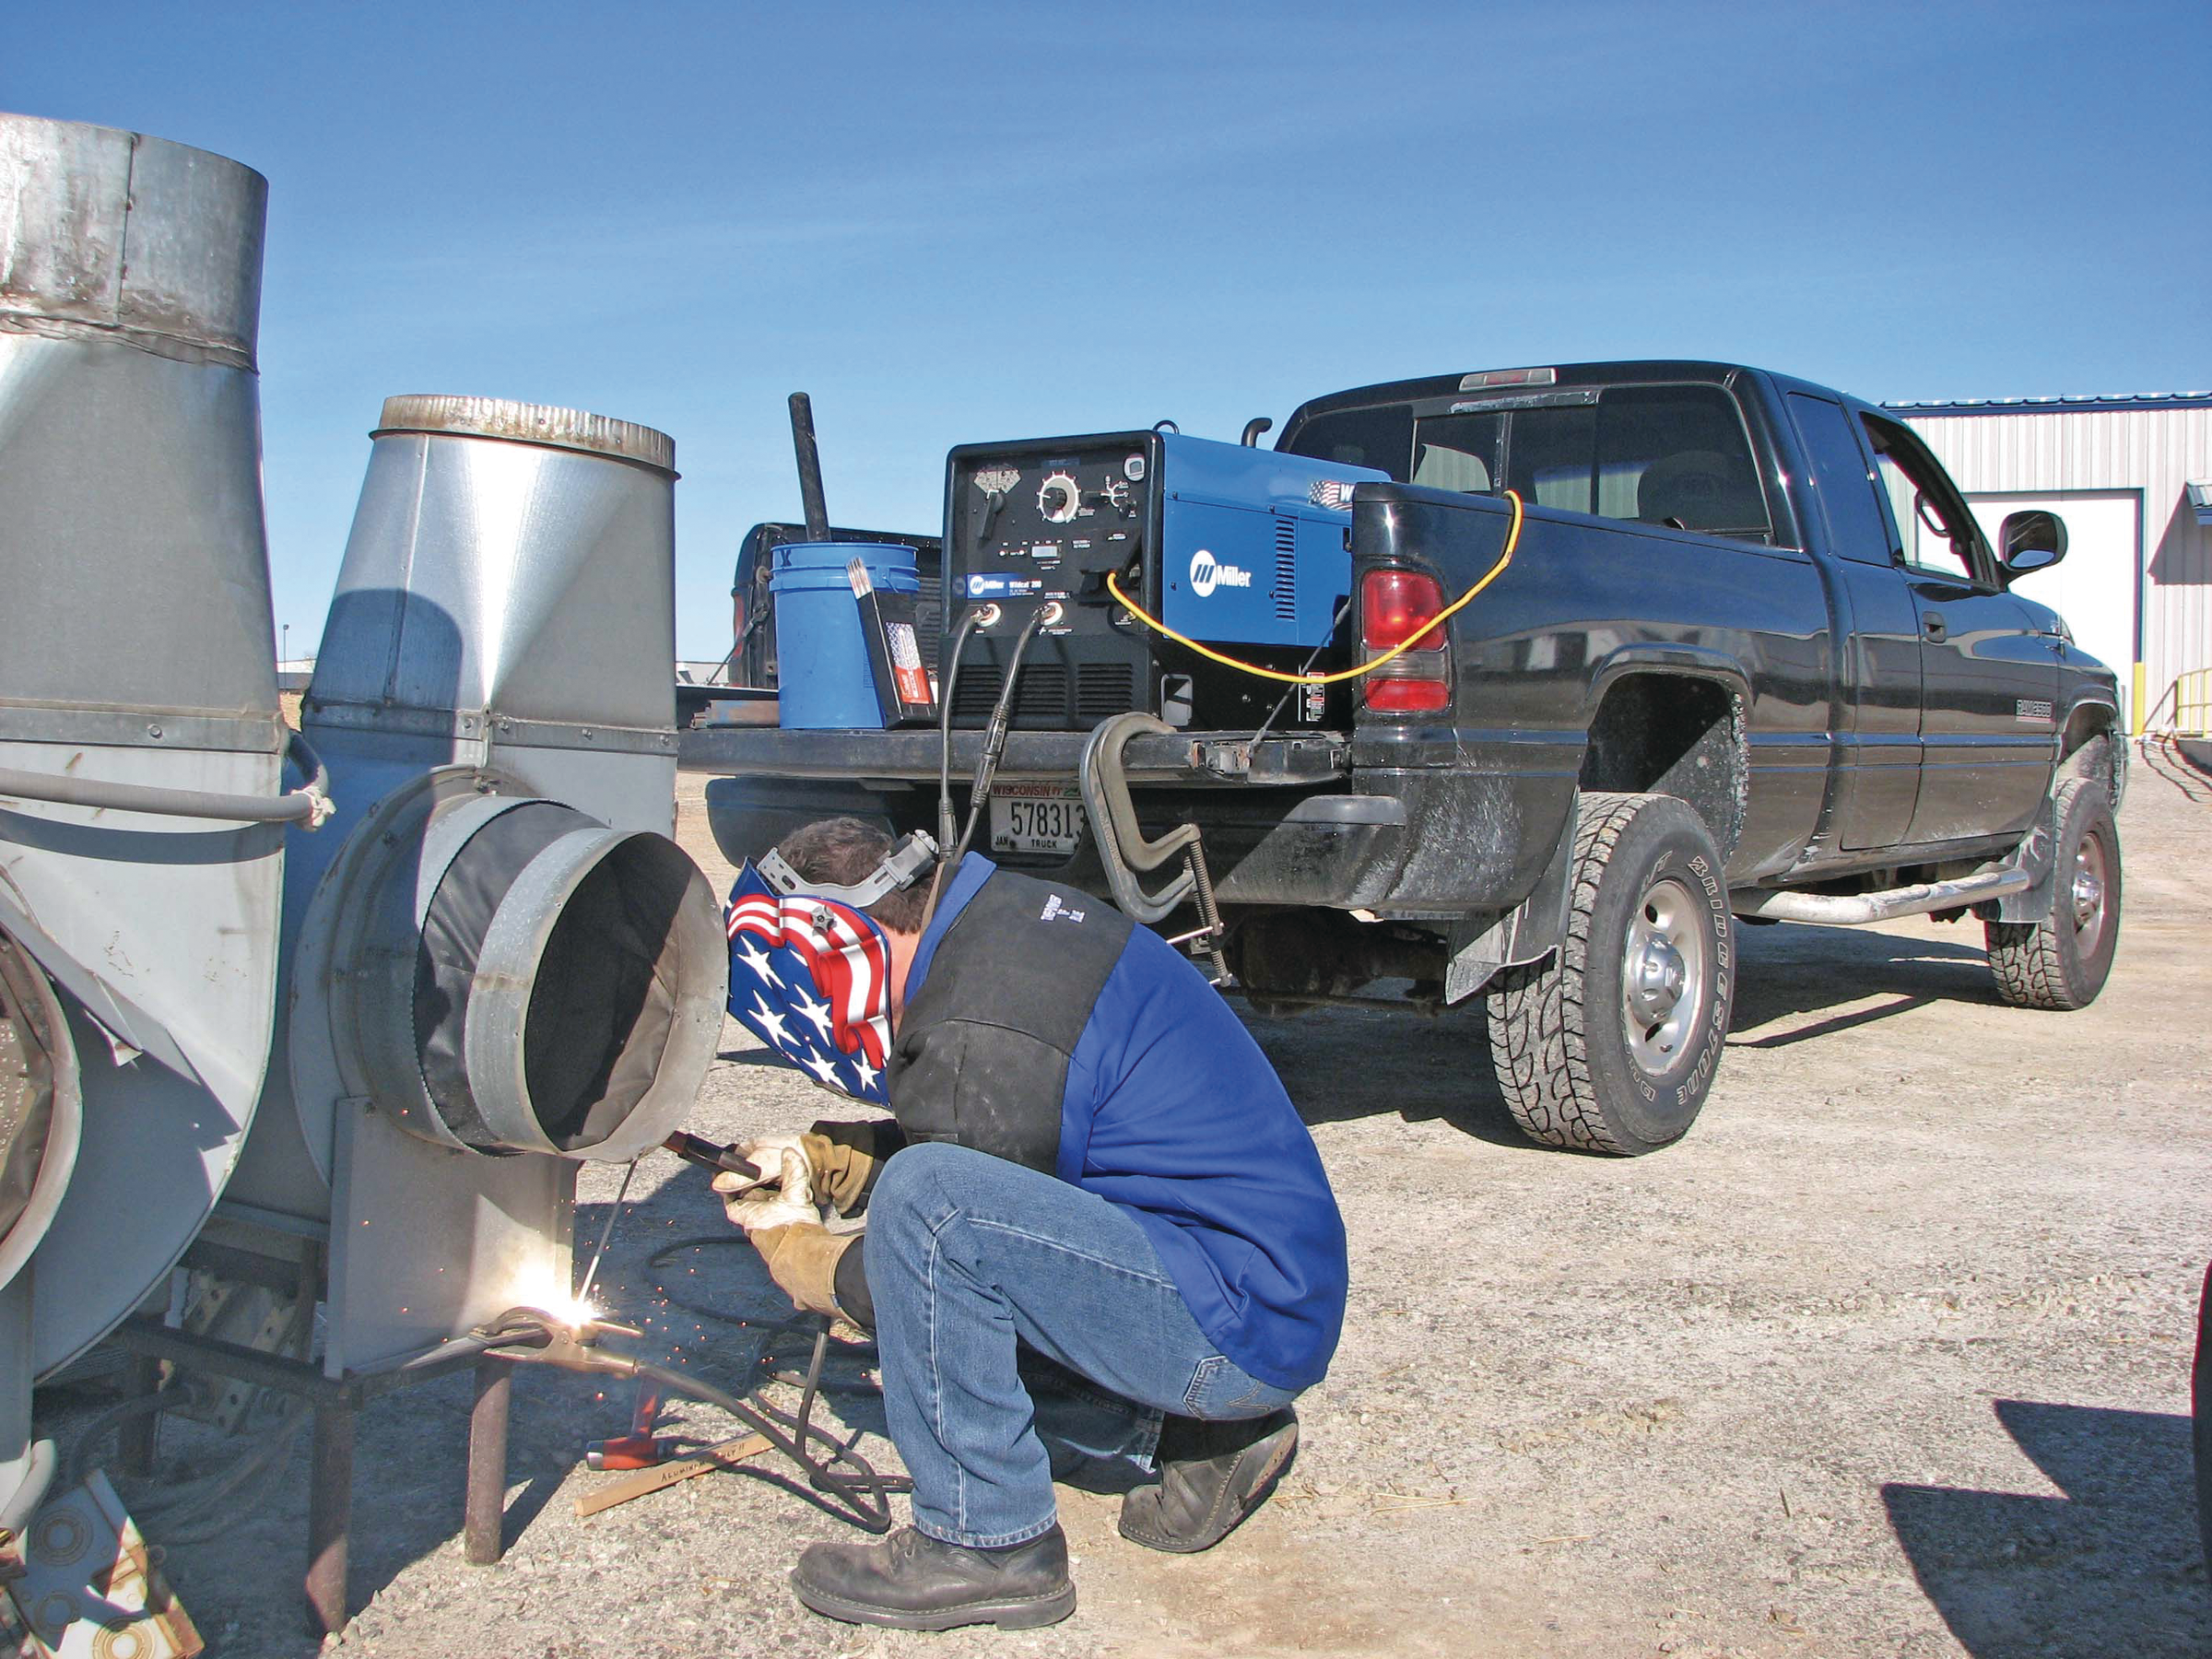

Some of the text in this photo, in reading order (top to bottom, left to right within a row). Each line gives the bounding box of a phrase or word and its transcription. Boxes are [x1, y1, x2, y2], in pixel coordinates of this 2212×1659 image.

[1217, 564, 1252, 587] Miller
[993, 783, 1050, 797] WISCONSIN
[1011, 802, 1087, 838] 578313
[995, 836, 1057, 848] JAN TRUCK
[1676, 855, 1730, 1105] BRIDGESTONE
